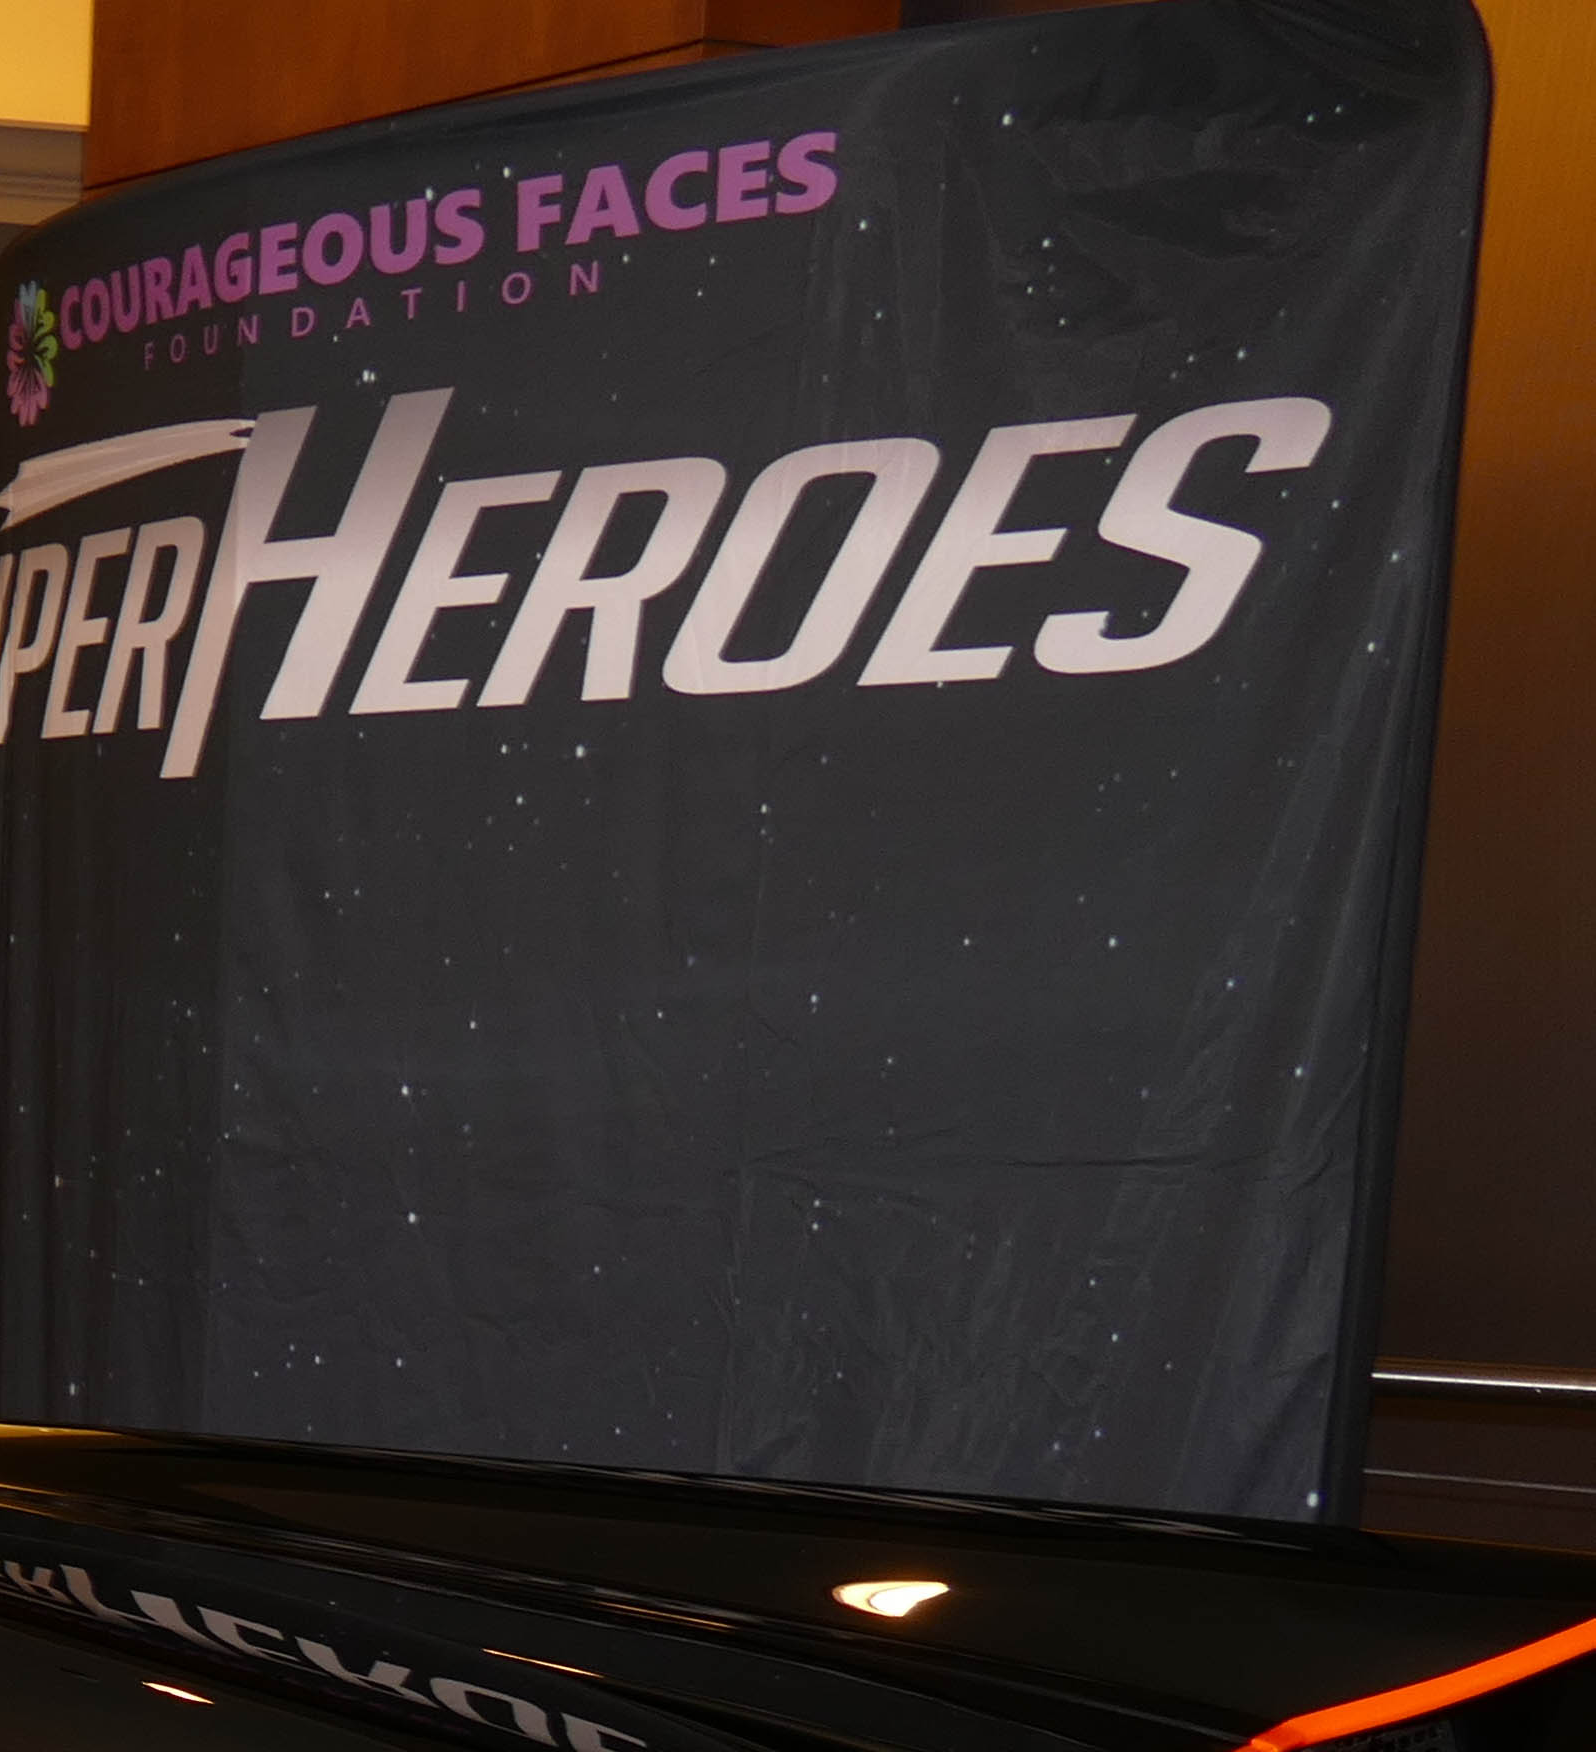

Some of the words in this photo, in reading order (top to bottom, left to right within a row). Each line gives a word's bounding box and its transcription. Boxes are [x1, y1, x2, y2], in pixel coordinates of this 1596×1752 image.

[59, 188, 486, 351] COURAGEOUS
[516, 131, 838, 254] FACES
[143, 260, 600, 371] FOUNDATION
